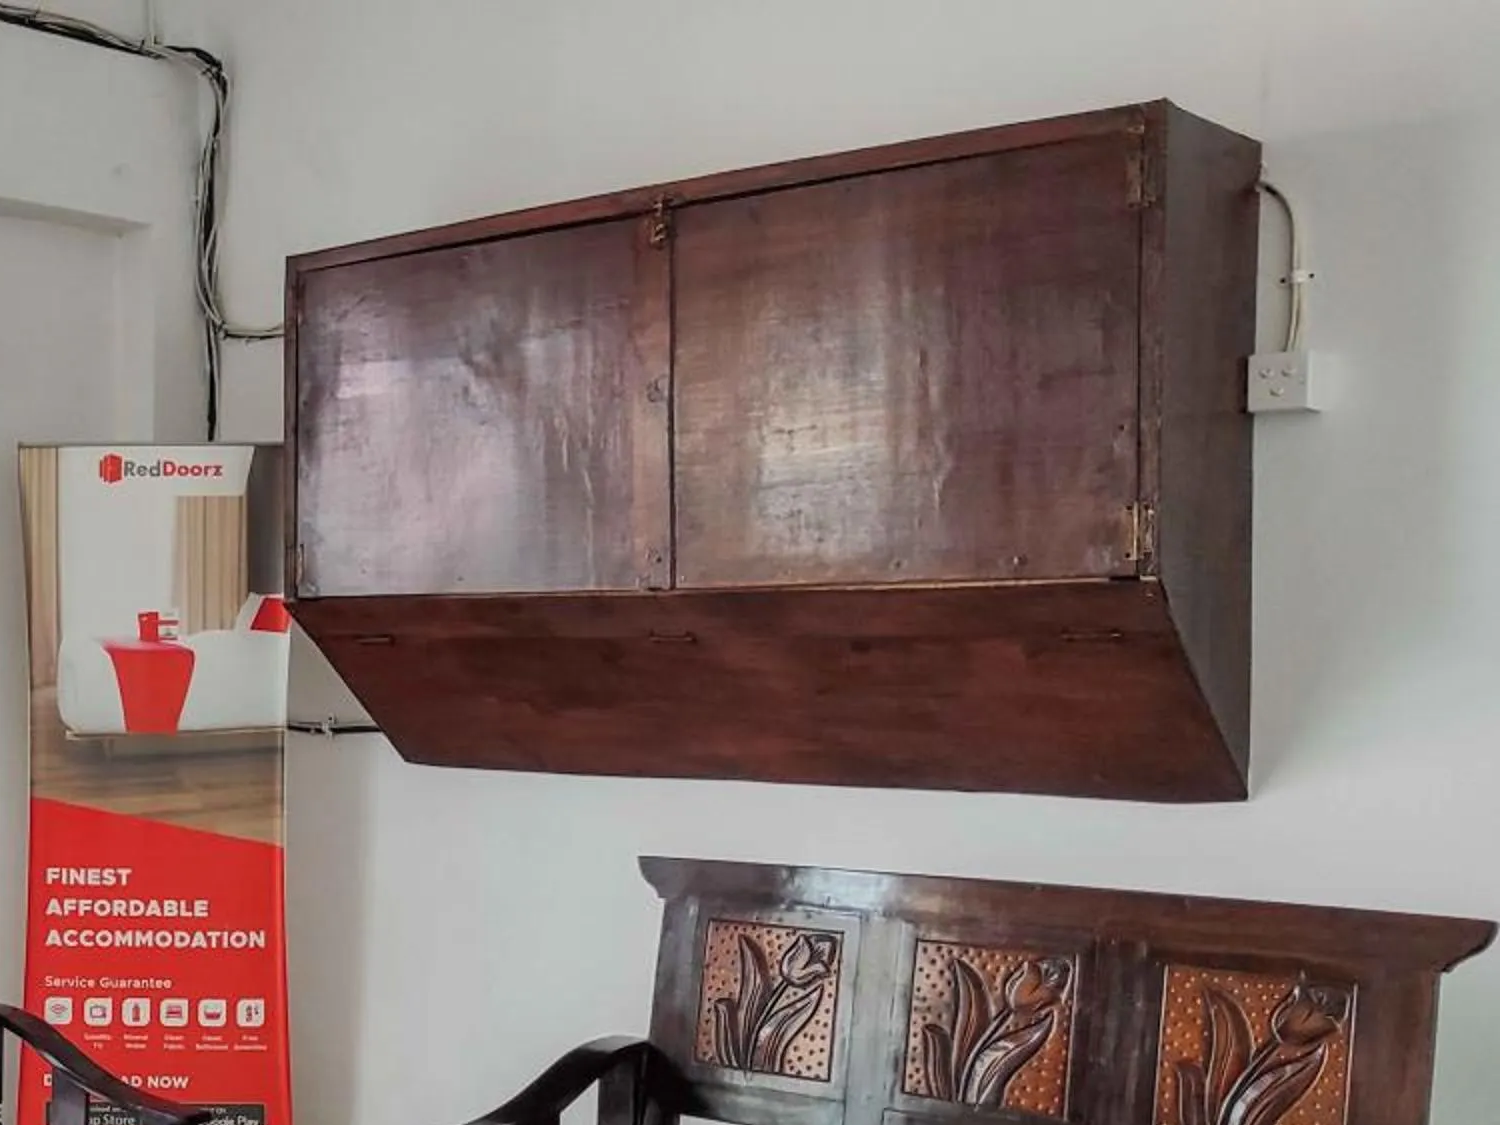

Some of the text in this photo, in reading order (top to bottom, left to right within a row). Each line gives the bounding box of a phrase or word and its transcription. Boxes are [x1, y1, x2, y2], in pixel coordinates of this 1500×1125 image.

[123, 459, 223, 477] RedDoorz
[45, 867, 132, 886] FINEST
[45, 898, 209, 917] AFFORDABLE
[45, 929, 266, 949] ACCOMMODATION
[44, 975, 172, 989] Service Guarantee
[147, 1075, 189, 1089] NOW
